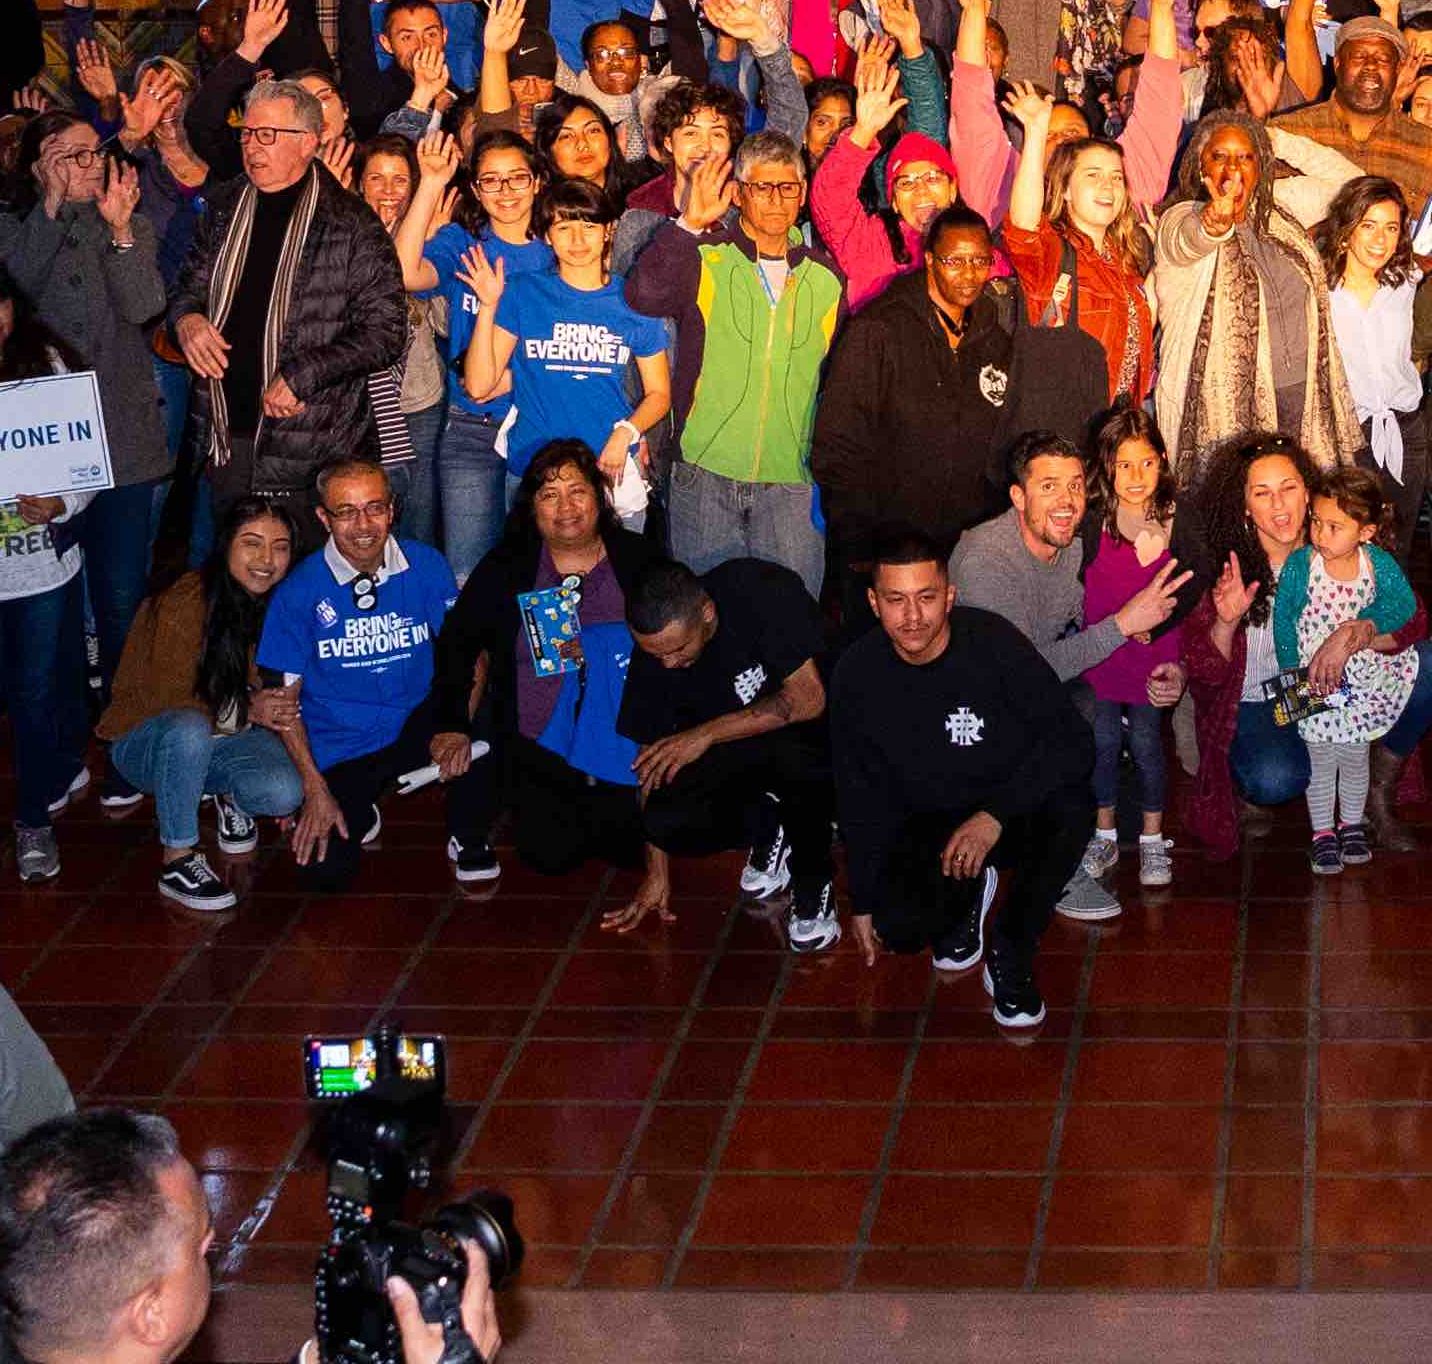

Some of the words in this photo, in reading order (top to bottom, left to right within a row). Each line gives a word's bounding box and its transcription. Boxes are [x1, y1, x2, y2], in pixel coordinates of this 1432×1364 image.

[553, 322, 609, 344] BRING
[525, 339, 617, 364] EVERYONE
[68, 420, 92, 442] IN
[344, 612, 399, 638] BRING
[318, 628, 412, 658] EVERYONE
[412, 622, 430, 645] IN
